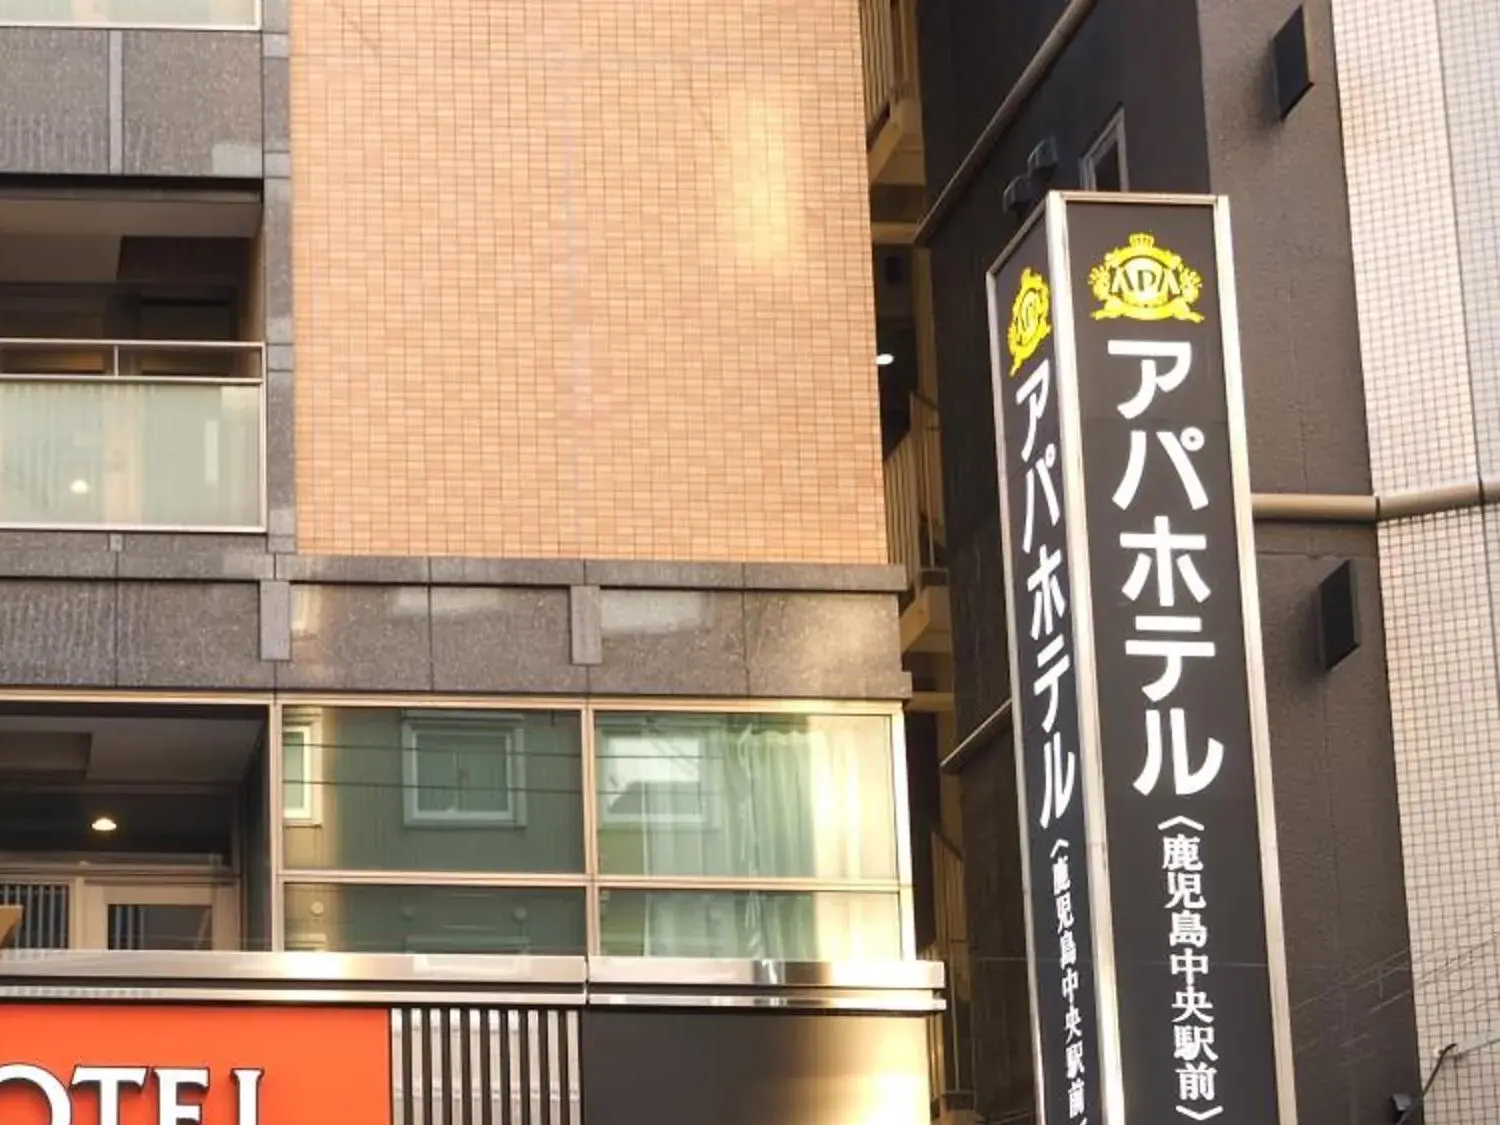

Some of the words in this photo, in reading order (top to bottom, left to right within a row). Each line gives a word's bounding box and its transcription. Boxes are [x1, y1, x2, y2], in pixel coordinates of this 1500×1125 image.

[1014, 357, 1076, 830] アパホテル
[1106, 338, 1224, 797] アパホテル
